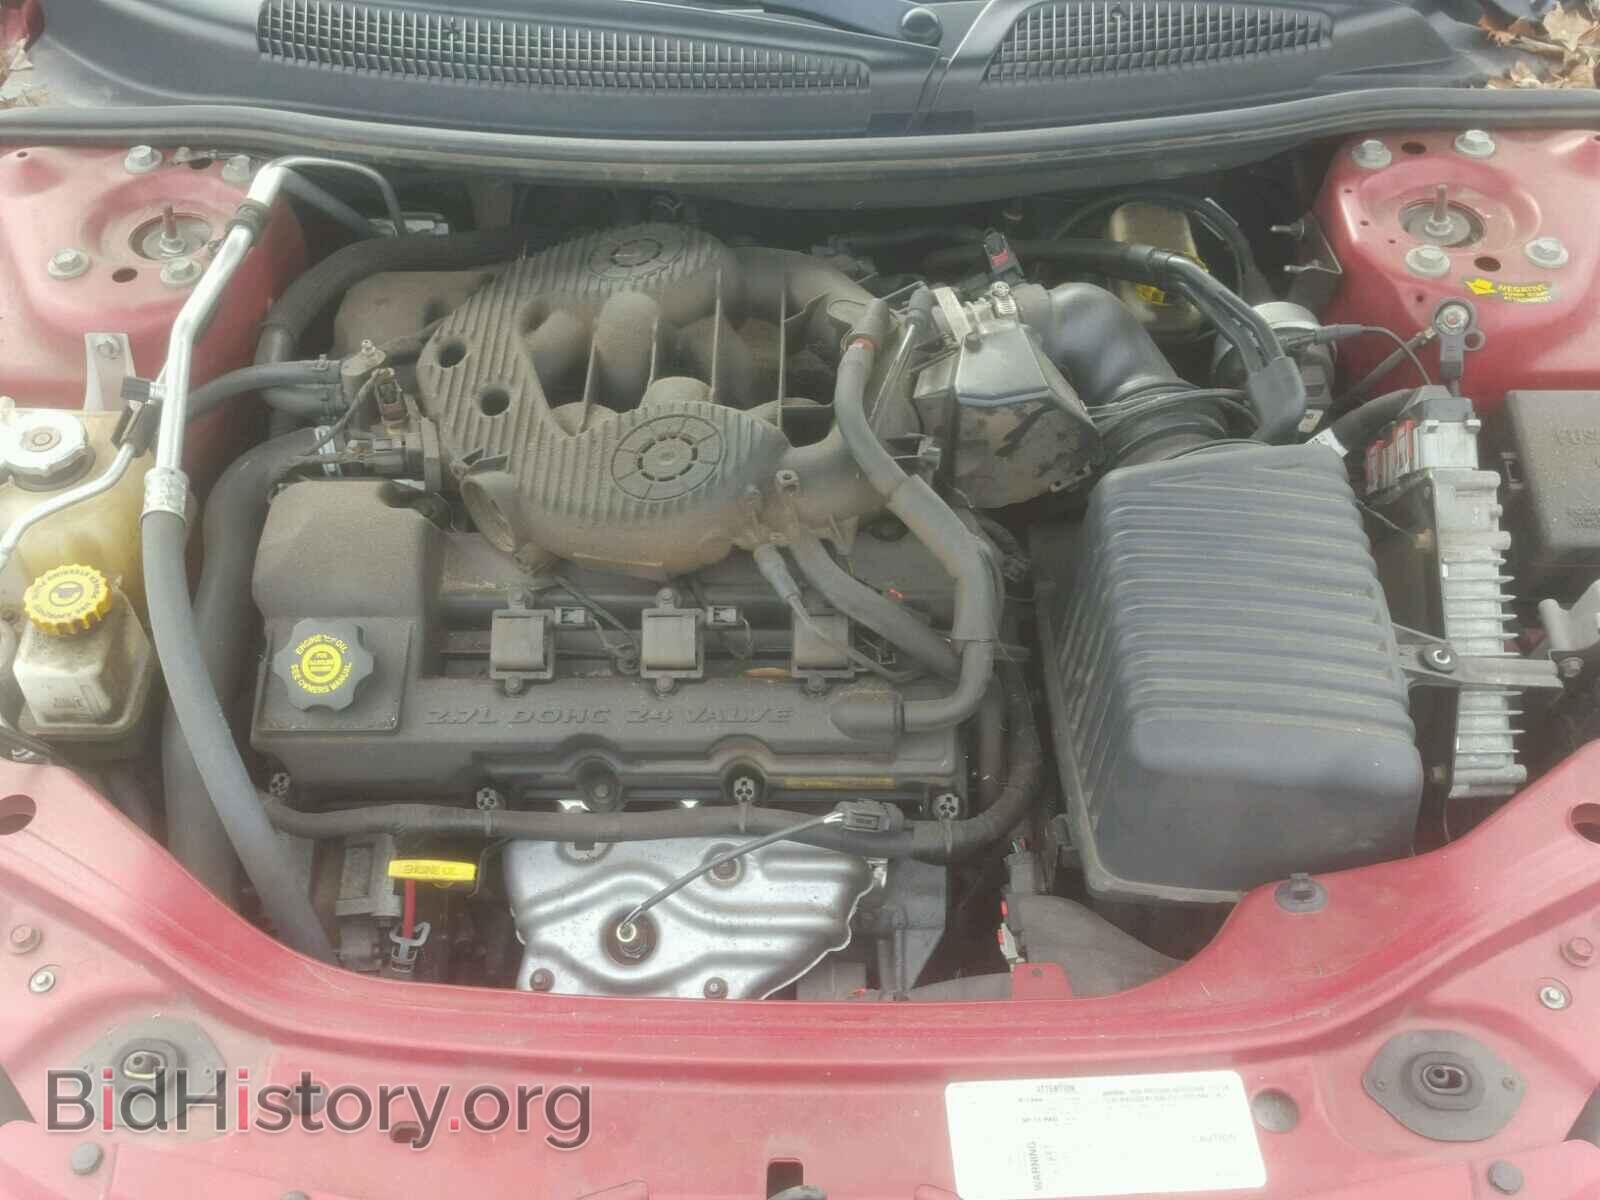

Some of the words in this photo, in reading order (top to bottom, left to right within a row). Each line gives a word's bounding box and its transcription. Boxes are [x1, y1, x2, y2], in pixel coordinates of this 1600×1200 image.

[424, 705, 498, 725] 2.7L
[507, 706, 611, 725] DOHC
[625, 706, 674, 724] 24
[686, 706, 794, 724] VALVE
[1027, 1140, 1043, 1192] WARNING
